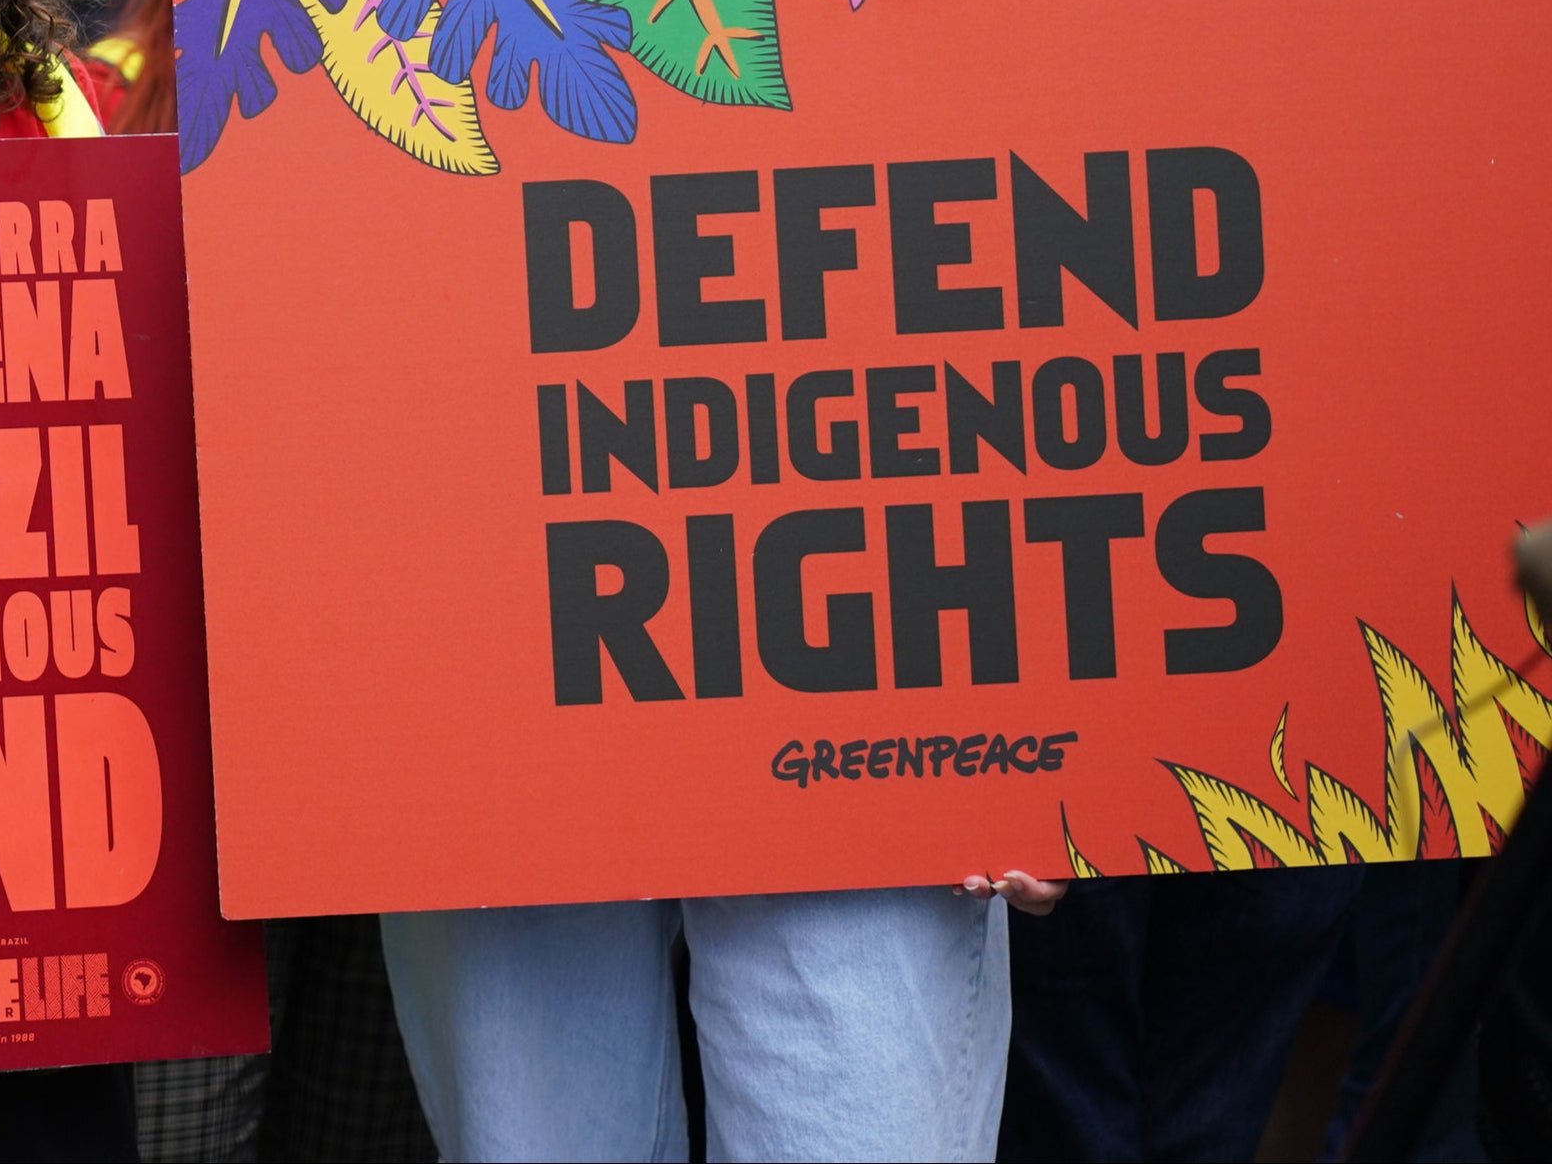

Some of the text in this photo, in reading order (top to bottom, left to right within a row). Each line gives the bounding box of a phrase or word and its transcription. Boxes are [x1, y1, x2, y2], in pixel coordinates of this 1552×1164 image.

[523, 146, 1264, 355] DEFEND
[537, 347, 1273, 496] INDIGENOUS
[544, 486, 1284, 706] RIGHTS
[772, 731, 1078, 788] GREENPEACE
[11, 1033, 36, 1043] 1988
[21, 952, 111, 1021] LIFE
